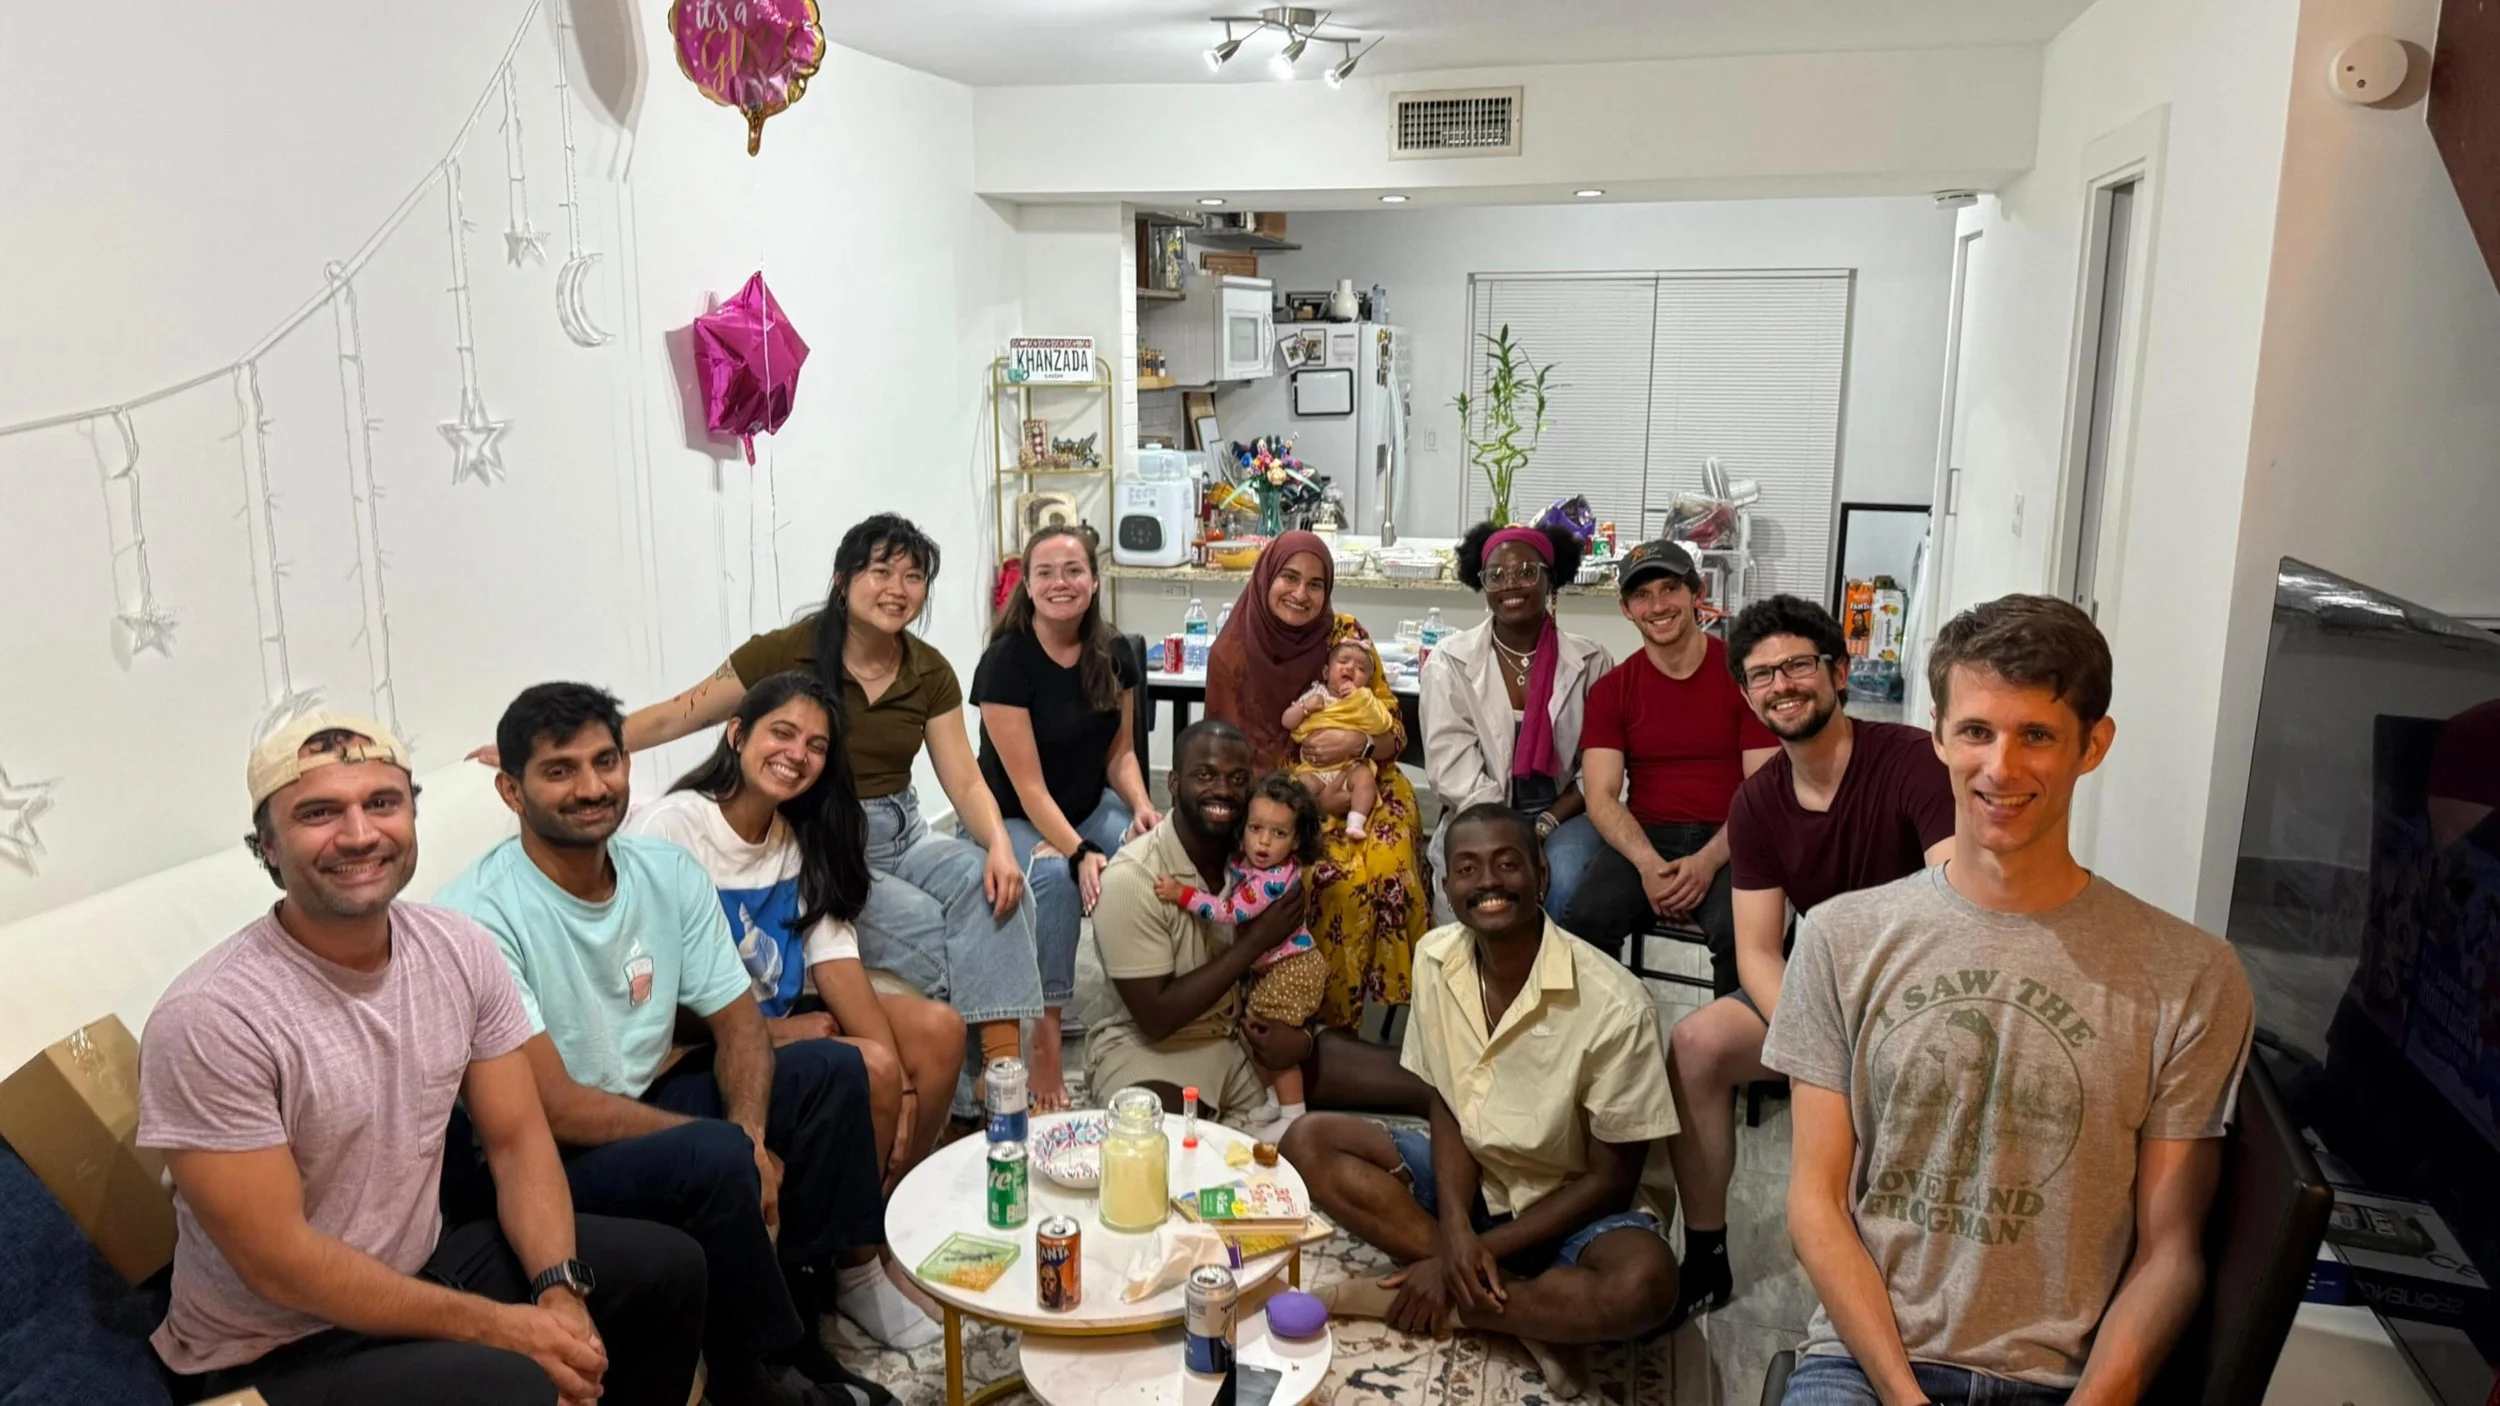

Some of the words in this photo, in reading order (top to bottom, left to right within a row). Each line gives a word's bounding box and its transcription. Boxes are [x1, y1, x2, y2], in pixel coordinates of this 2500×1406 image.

[1016, 349, 1089, 372] KHANZADA
[1877, 1007, 1895, 1029] I
[1902, 970, 1999, 1011] SAW
[2015, 977, 2097, 1048] THE
[1877, 1168, 2045, 1217] OVELAND
[1863, 1192, 2025, 1245] FROGMAN
